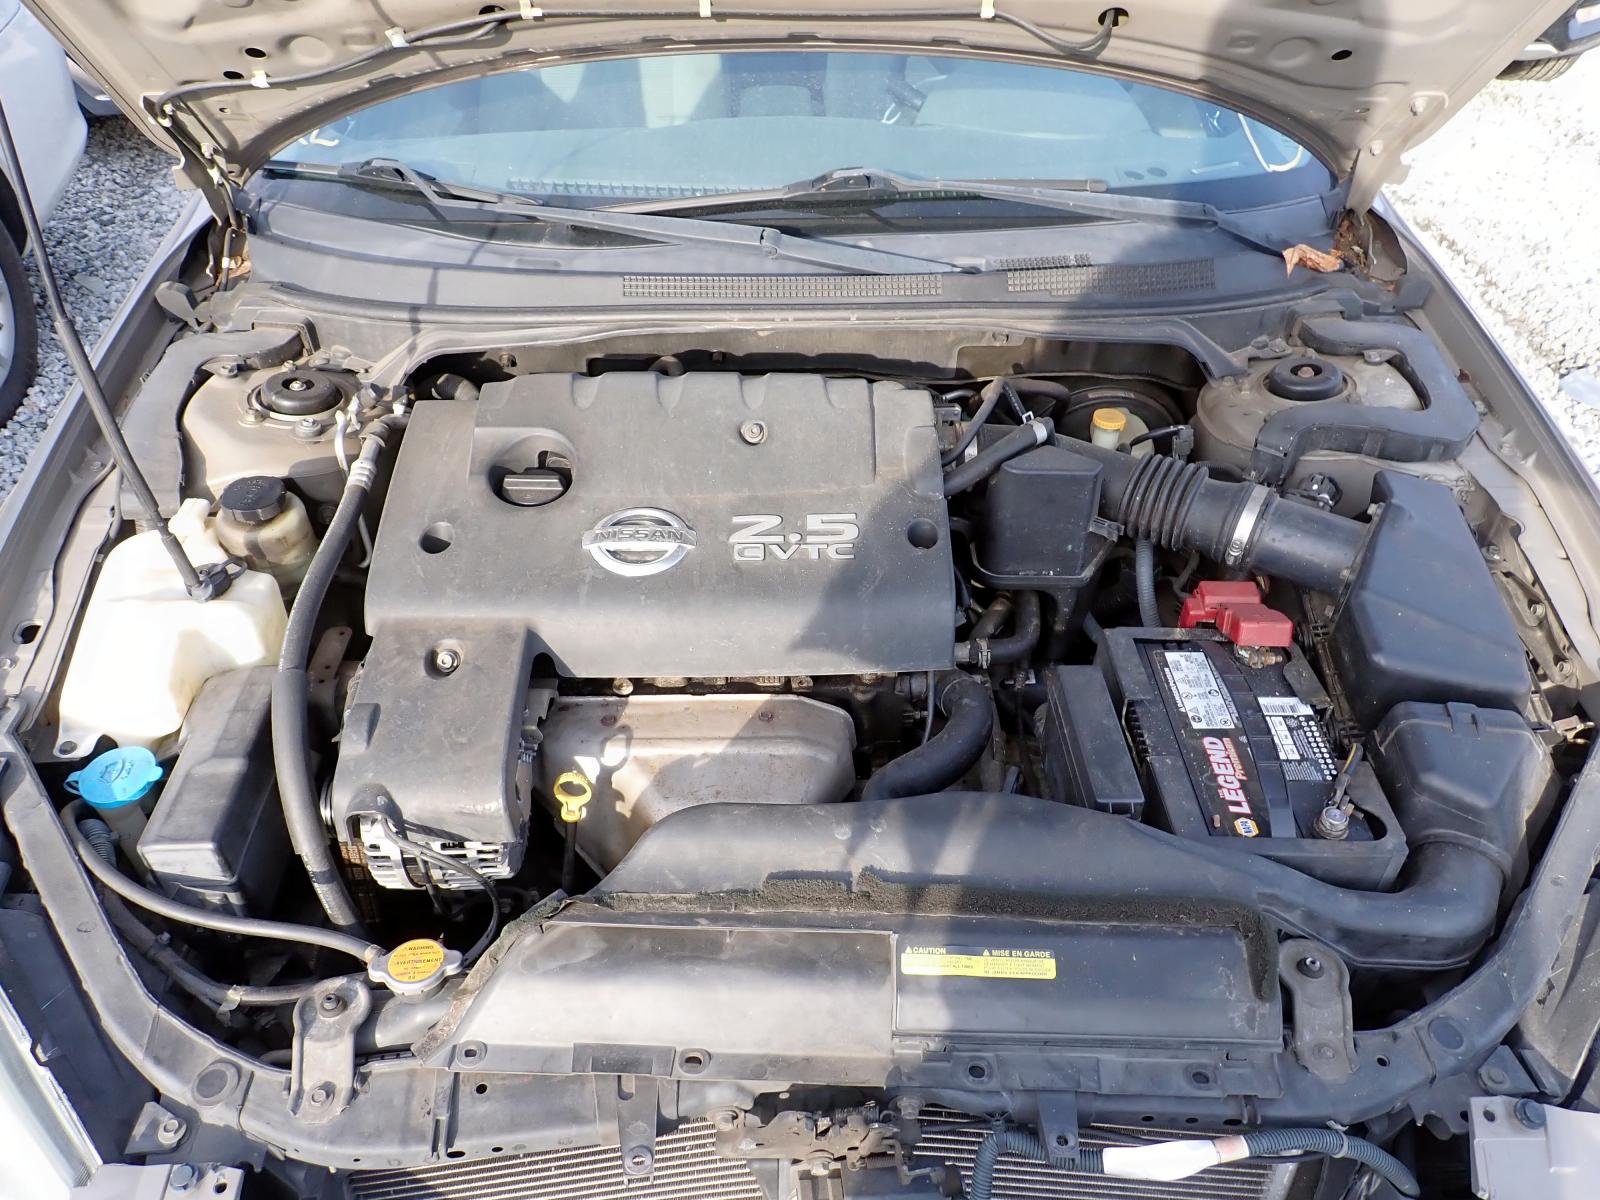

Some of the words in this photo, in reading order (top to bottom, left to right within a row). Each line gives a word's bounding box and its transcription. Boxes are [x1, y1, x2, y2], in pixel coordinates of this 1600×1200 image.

[595, 528, 684, 541] NISSAN
[729, 514, 859, 543] 2.5
[1203, 736, 1251, 814] LEGEND
[912, 946, 946, 955] CAUTION
[991, 949, 1010, 957] MISE
[1023, 950, 1051, 958] GARDE
